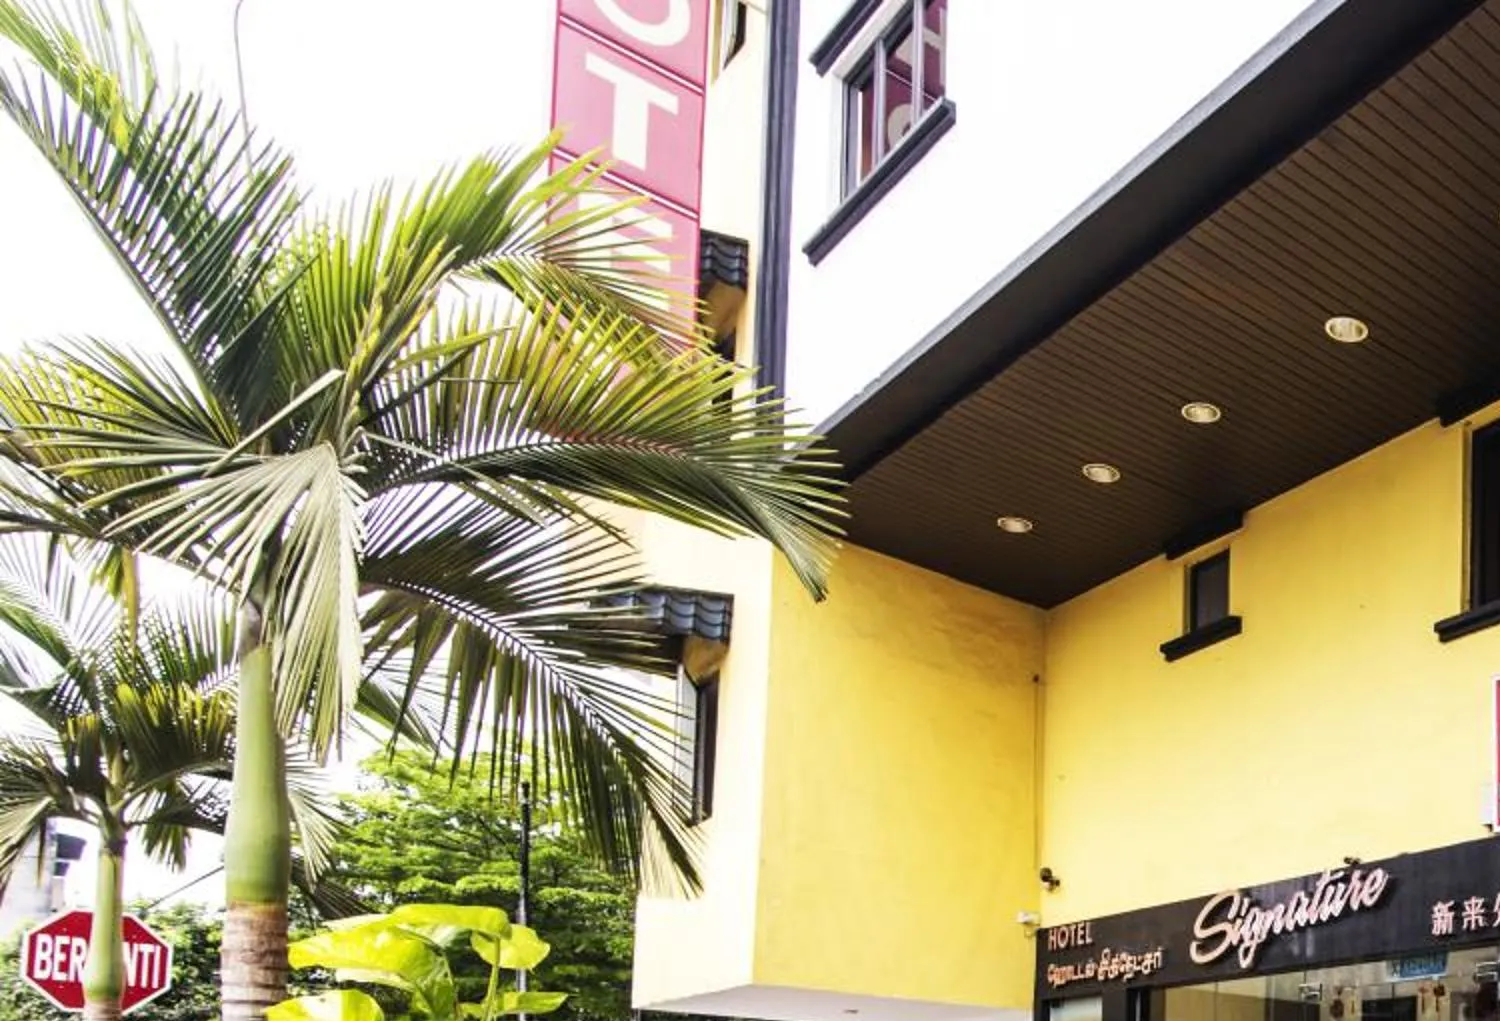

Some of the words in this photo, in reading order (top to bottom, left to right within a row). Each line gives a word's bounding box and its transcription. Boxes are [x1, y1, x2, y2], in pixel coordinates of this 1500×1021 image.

[1047, 921, 1093, 951] HOTEL
[1189, 867, 1389, 969] Signature
[33, 933, 162, 989] BERNTI
